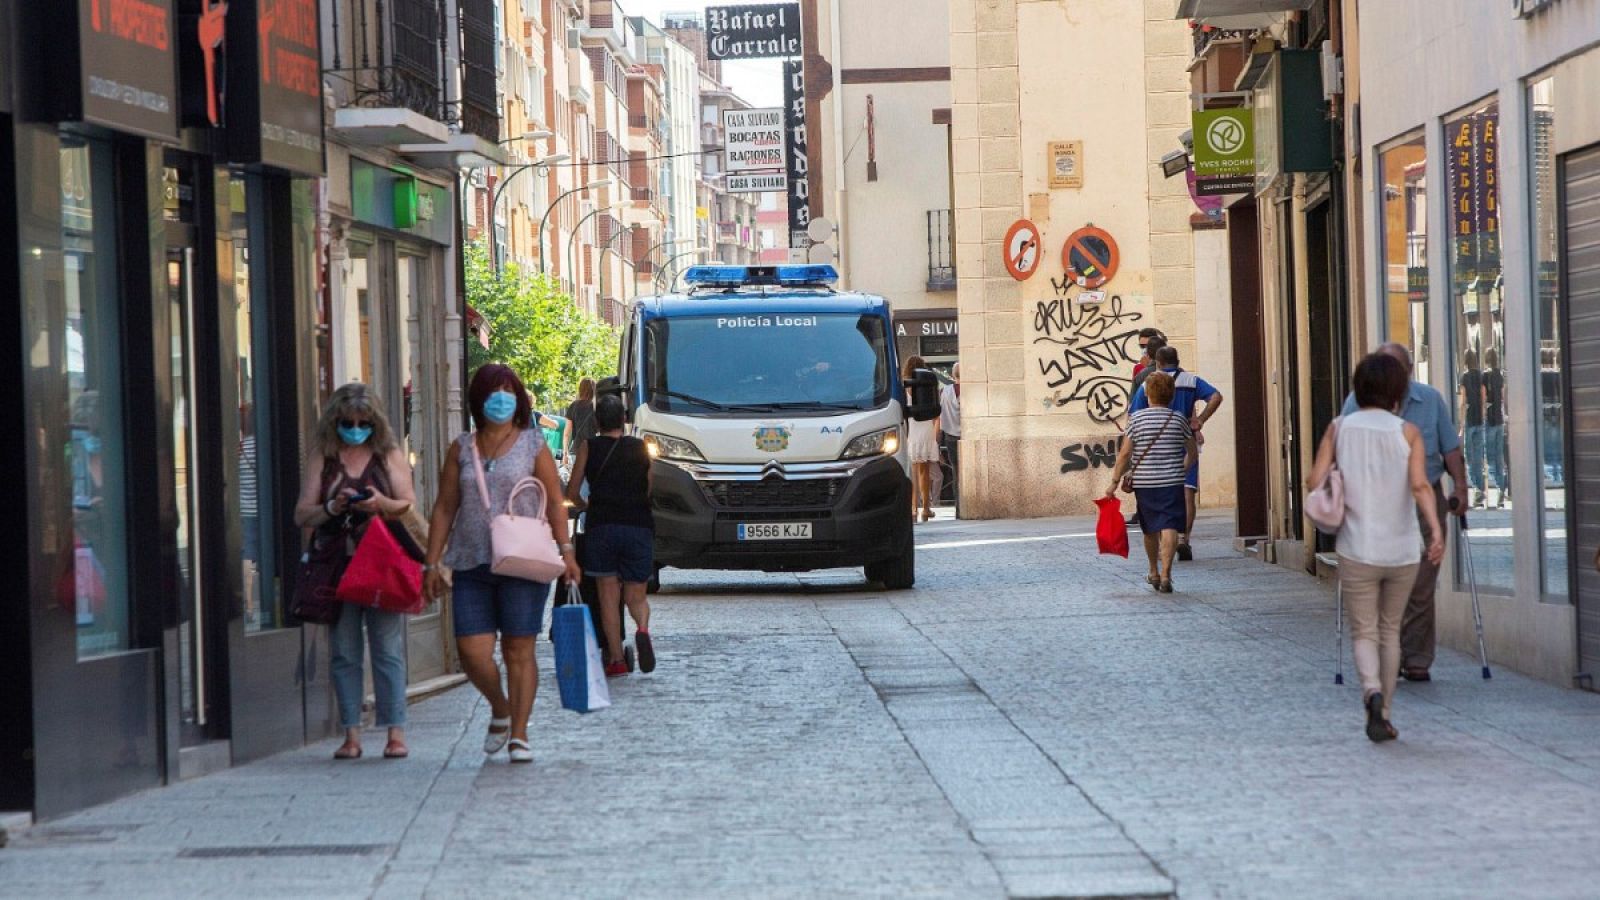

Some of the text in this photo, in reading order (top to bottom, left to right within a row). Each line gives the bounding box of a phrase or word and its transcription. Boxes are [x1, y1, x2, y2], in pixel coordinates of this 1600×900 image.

[710, 8, 785, 34] Rafael
[711, 33, 802, 57] Corrale
[727, 112, 779, 127] CASA SILVIANO
[729, 130, 780, 143] BOCATAS
[730, 149, 781, 162] RACIONES
[1199, 160, 1220, 168] YVES
[730, 177, 785, 189] CASA SILVIANO
[717, 315, 816, 328] Policía Local
[820, 425, 843, 434] A-4
[747, 523, 808, 537] 9566 KJZ
